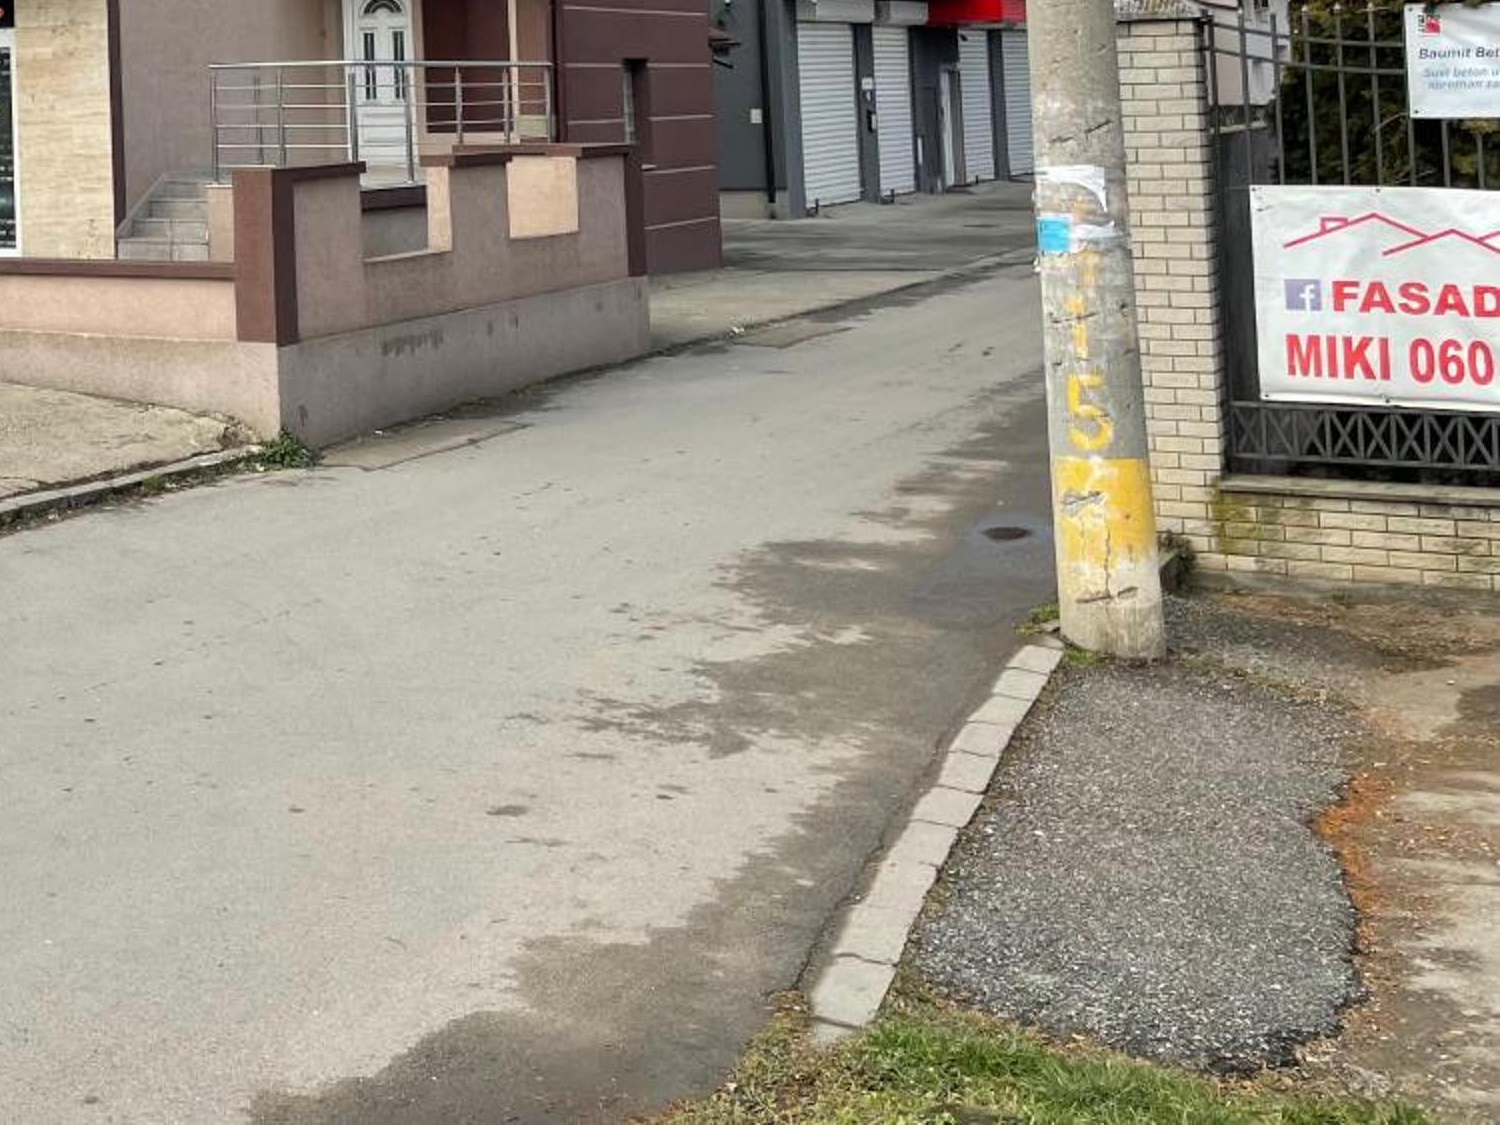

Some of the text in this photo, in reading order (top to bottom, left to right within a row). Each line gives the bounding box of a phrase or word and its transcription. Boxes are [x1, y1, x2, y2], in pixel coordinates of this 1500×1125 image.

[1332, 280, 1500, 318] FASAD
[1286, 333, 1495, 386] MIKI 060
